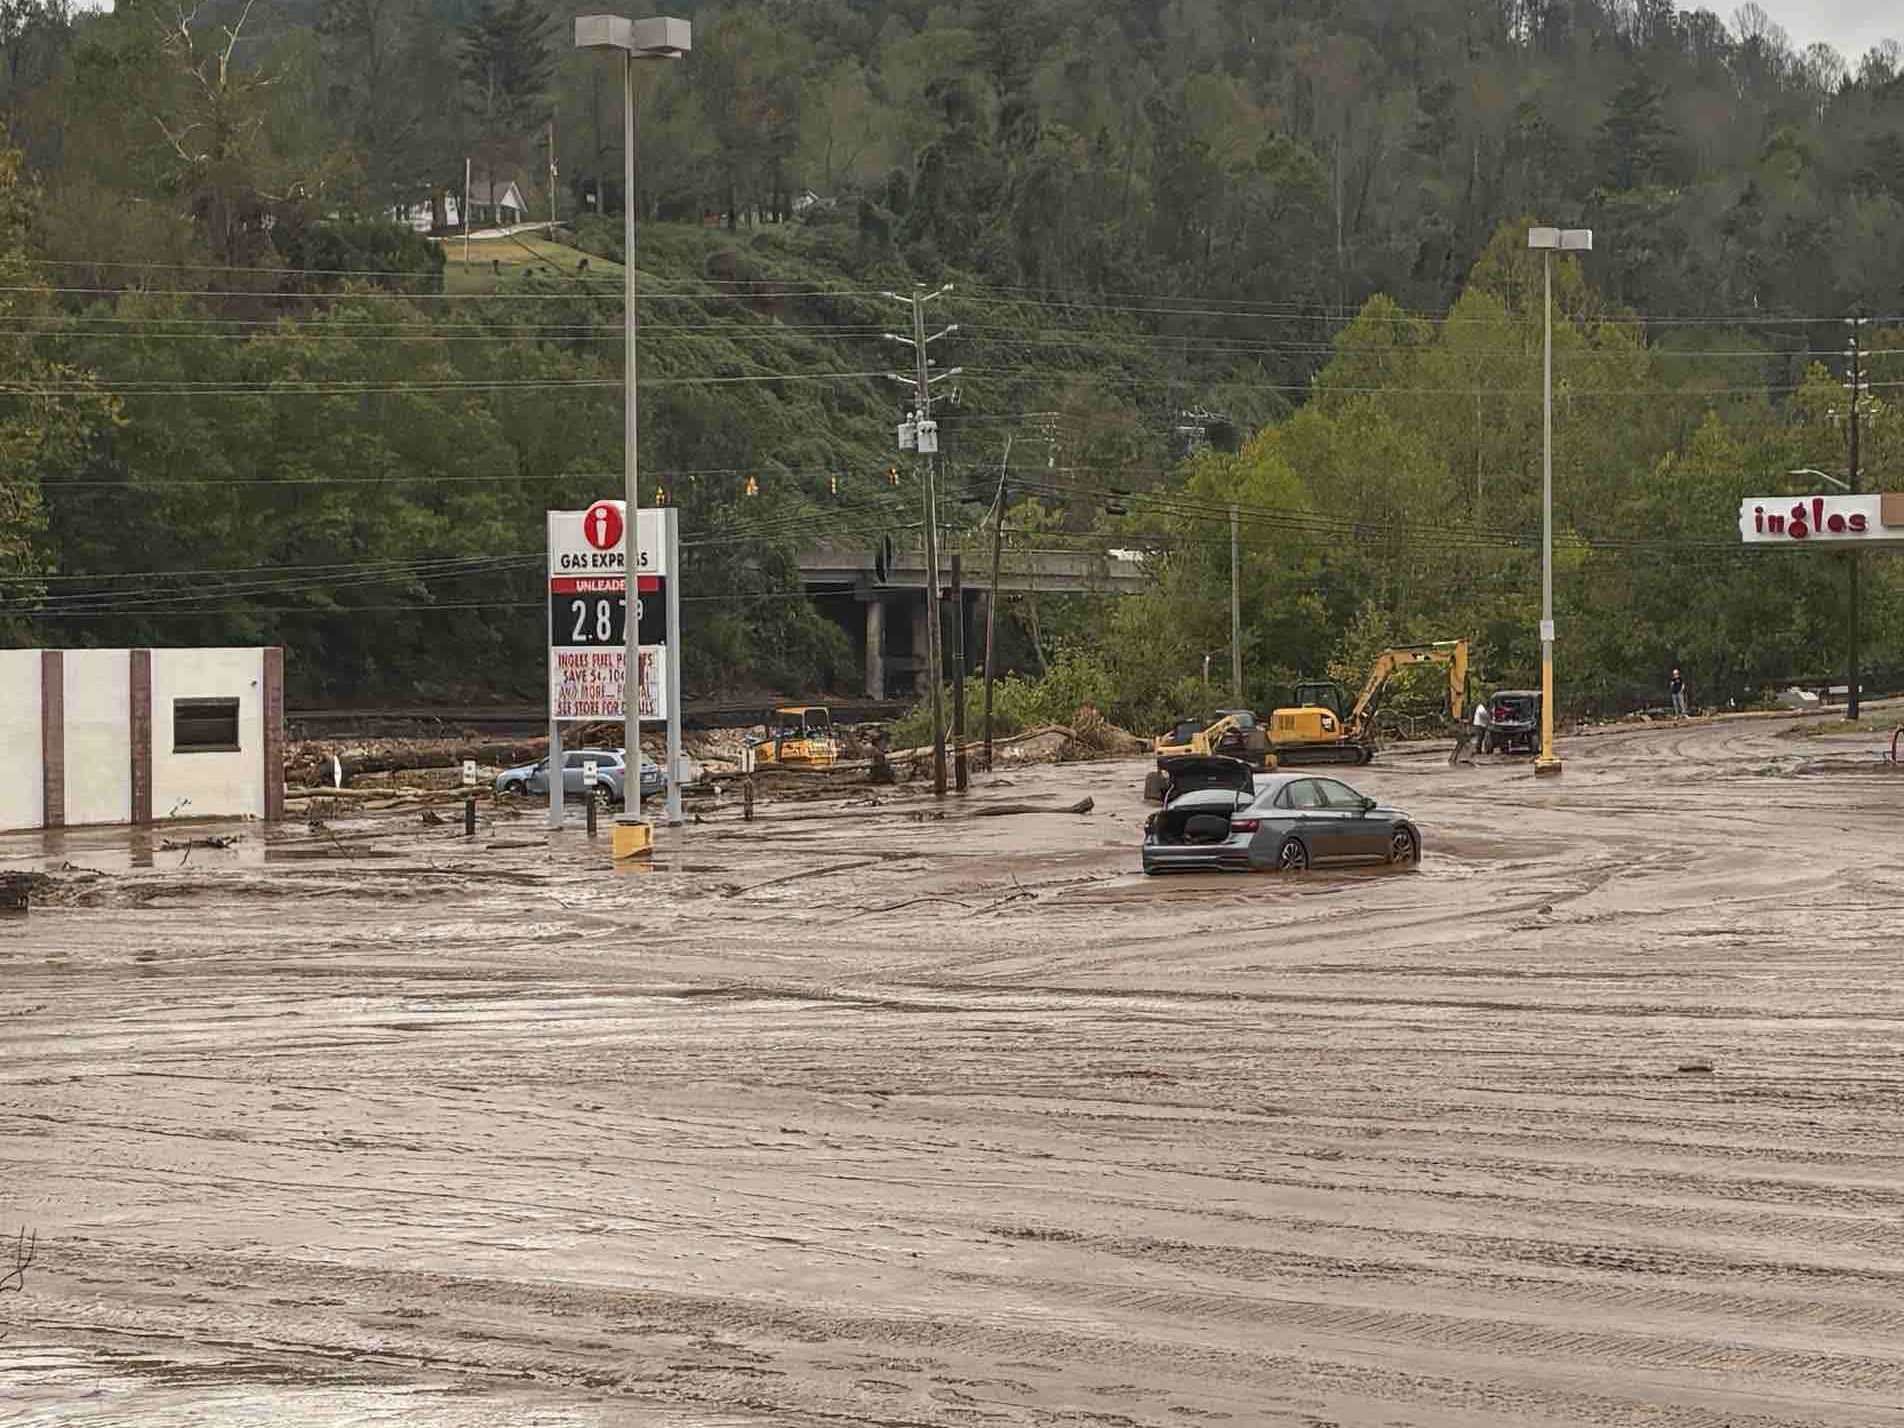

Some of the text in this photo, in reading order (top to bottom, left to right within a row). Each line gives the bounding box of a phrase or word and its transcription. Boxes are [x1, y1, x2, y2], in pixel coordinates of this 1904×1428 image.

[1754, 498, 1867, 539] ingles
[560, 552, 648, 569] GAS EXPRS
[576, 579, 627, 591] UNLEADE
[563, 669, 587, 684] SAVE
